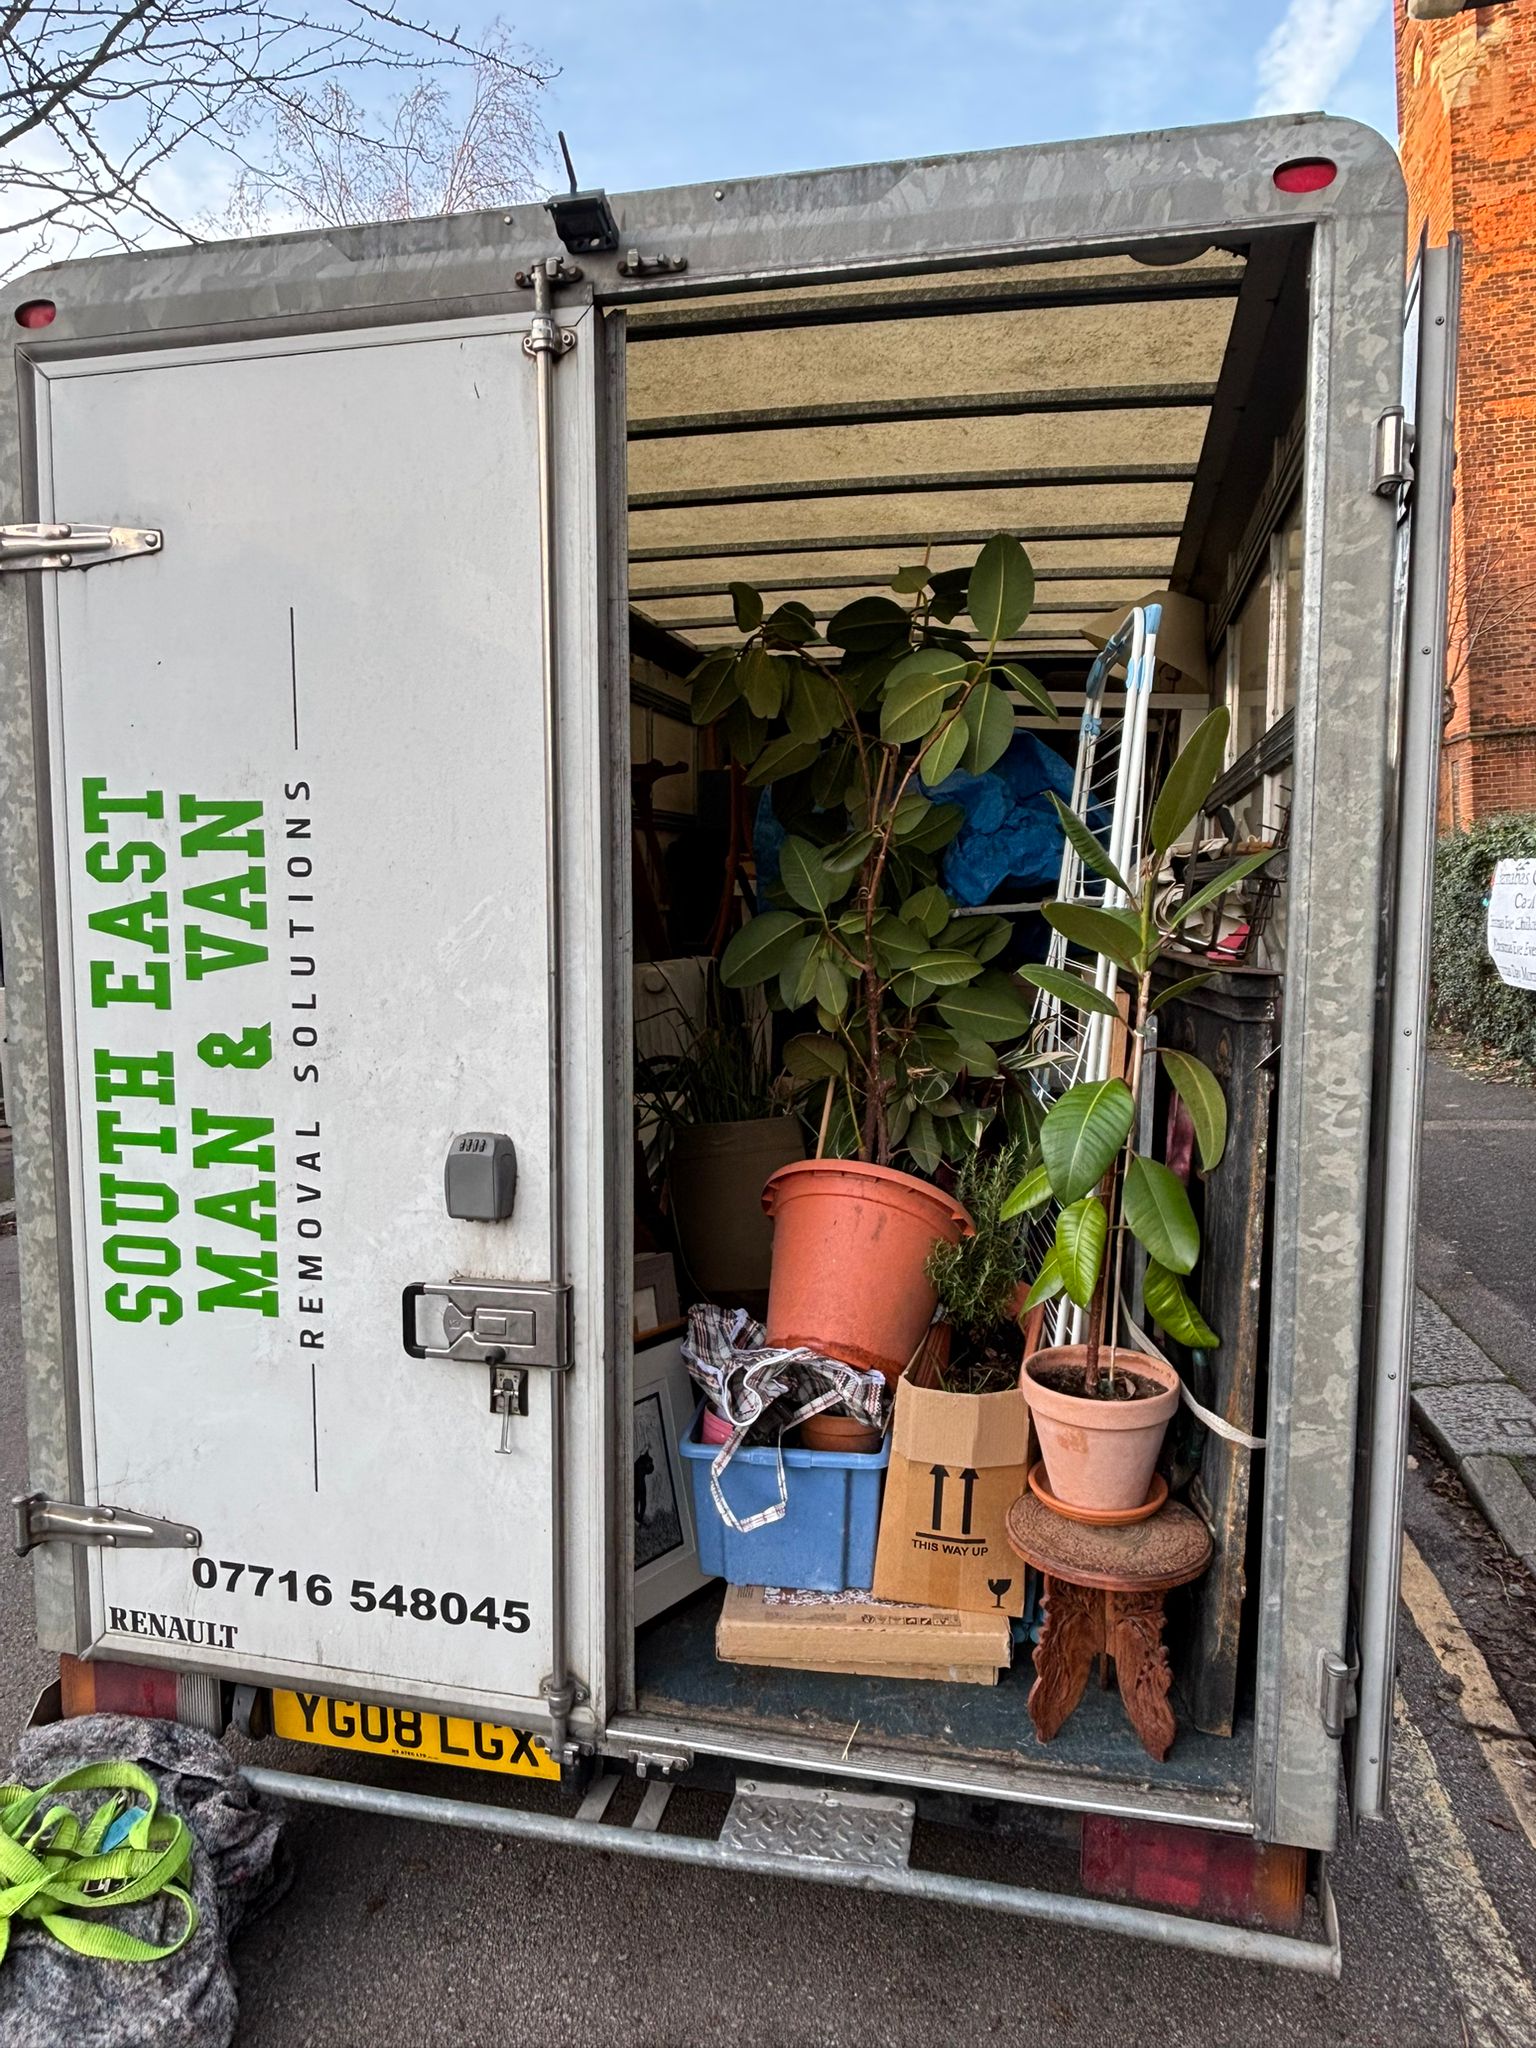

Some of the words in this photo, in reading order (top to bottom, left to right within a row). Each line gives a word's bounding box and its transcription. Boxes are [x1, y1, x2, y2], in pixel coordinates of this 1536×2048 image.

[82, 777, 171, 1010] EAST
[179, 794, 268, 981] VAN
[284, 781, 319, 1083] SOLUTIONS
[198, 1022, 272, 1069] &
[94, 1049, 182, 1325] SOUTH
[191, 1108, 278, 1318] MAN
[296, 1122, 324, 1348] REMOVAL
[108, 1606, 239, 1649] RENAULT
[193, 1557, 333, 1607] 07716
[349, 1579, 531, 1633] 548045
[911, 1538, 939, 1552] THIS
[942, 1543, 970, 1557] WAY
[971, 1546, 989, 1557] UP
[295, 1691, 422, 1749] YG08
[438, 1713, 540, 1767] LGX
